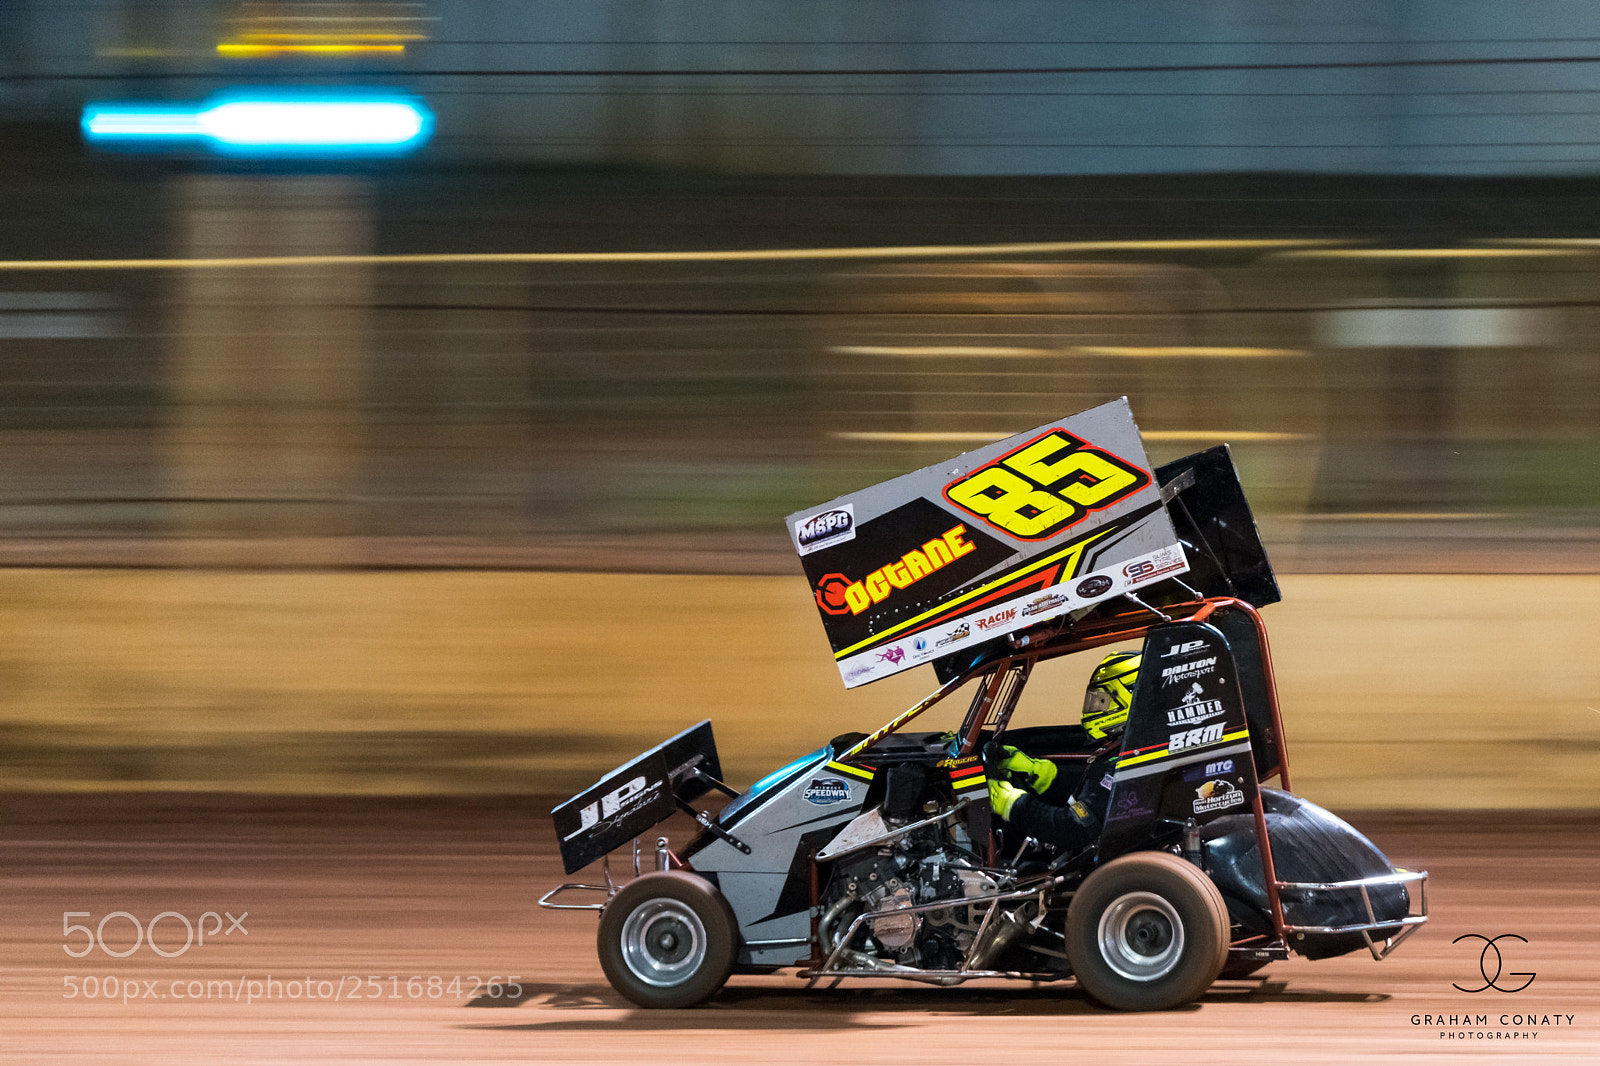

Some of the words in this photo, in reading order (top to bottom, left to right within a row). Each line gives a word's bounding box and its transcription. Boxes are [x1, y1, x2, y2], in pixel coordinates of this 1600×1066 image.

[945, 430, 1148, 540] 85
[800, 512, 849, 541] MSPG
[1161, 640, 1204, 658] JP
[1162, 656, 1217, 677] DALTON
[1162, 666, 1215, 688] Motorsport
[1167, 700, 1222, 722] HAMMER
[1168, 721, 1227, 751] BRM
[1205, 759, 1233, 774] MTC
[804, 789, 851, 799] SPEEDWAY
[563, 776, 646, 842] JP
